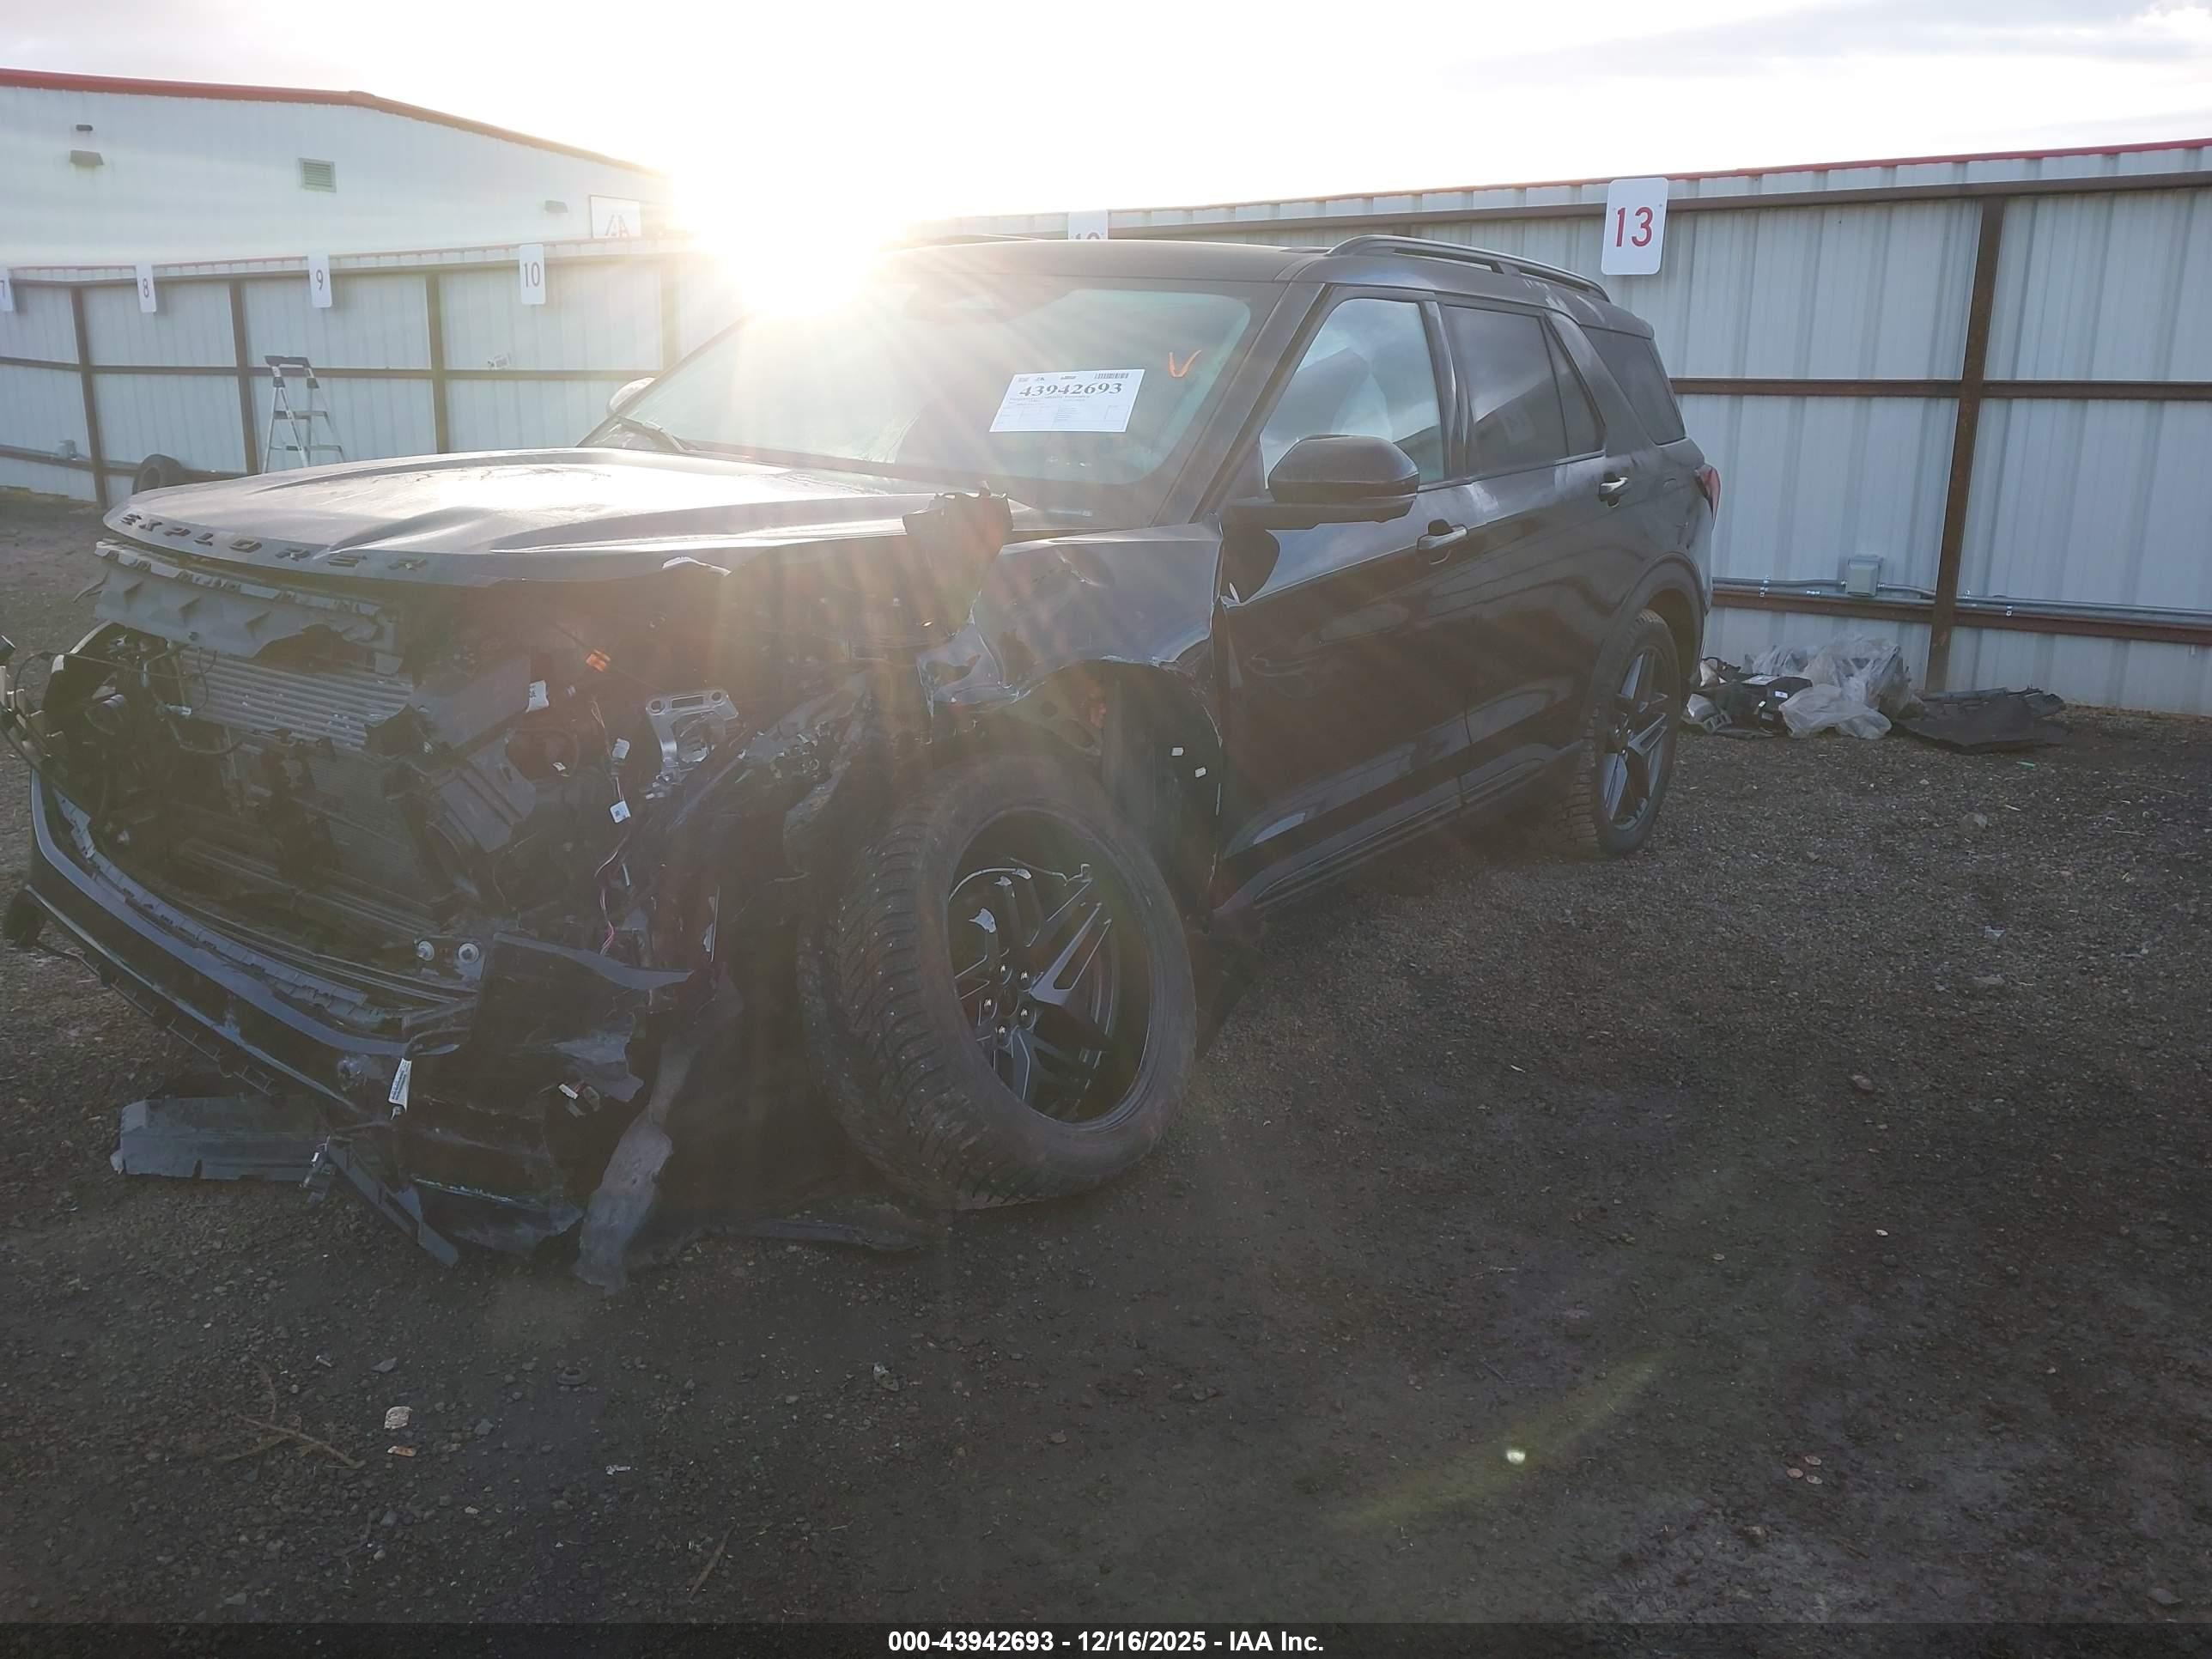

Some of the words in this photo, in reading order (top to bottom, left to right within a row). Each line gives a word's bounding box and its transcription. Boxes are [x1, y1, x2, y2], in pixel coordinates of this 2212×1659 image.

[1616, 207, 1654, 247] 13
[316, 269, 324, 290] 9
[524, 262, 541, 288] 10
[143, 278, 149, 298] 8
[1019, 382, 1122, 397] 43942693
[119, 514, 428, 571] EXPLORER
